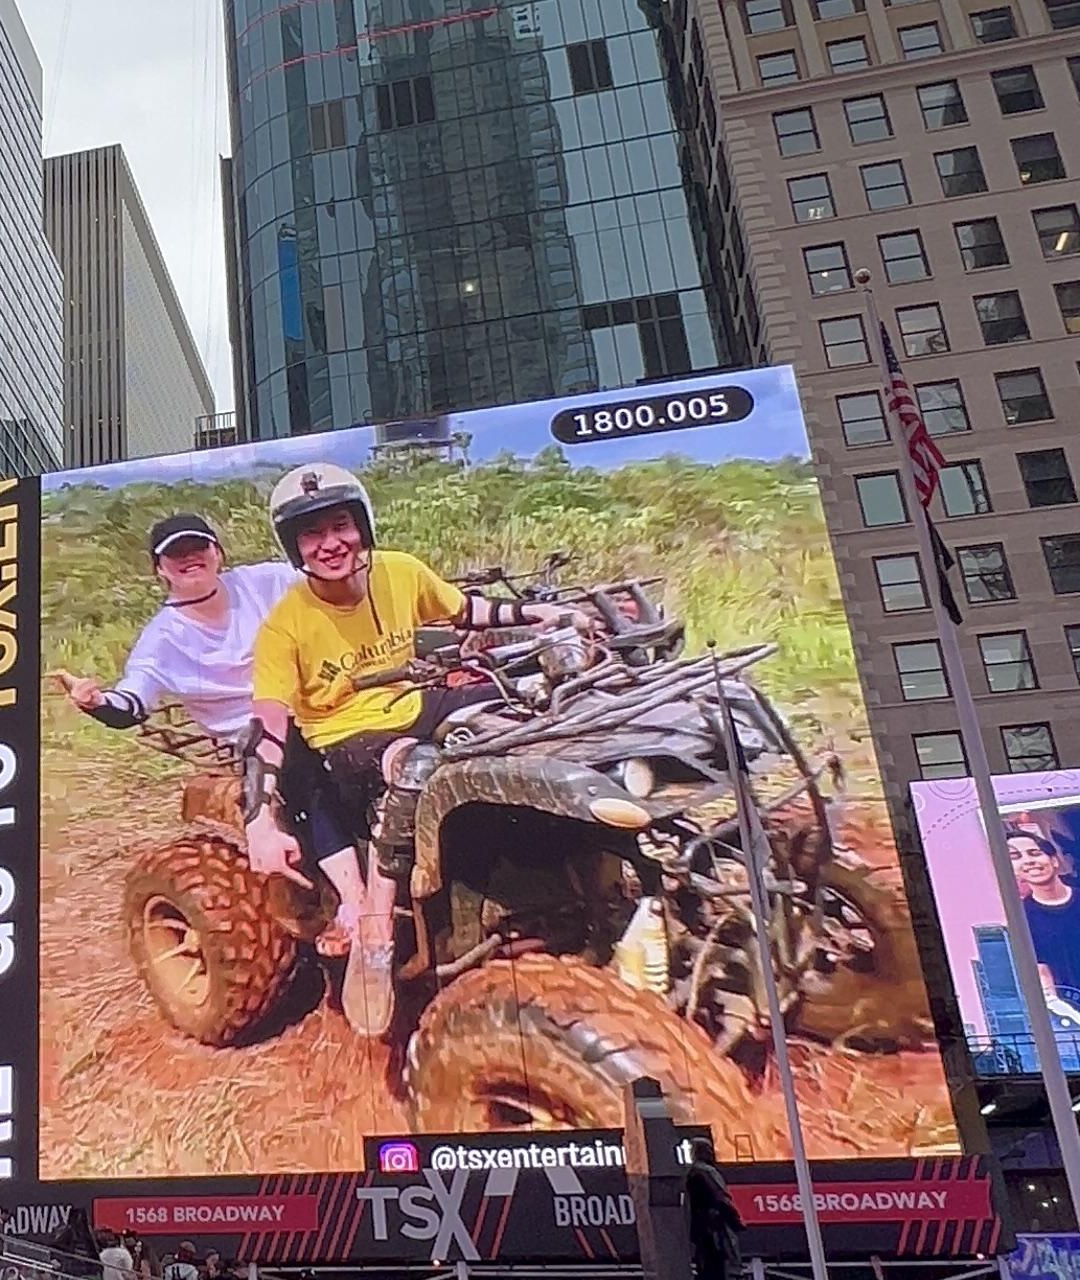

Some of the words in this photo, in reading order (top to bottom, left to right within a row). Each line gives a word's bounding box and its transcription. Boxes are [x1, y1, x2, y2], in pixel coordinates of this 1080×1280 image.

[573, 394, 729, 436] 1800.005
[126, 1207, 168, 1224] 1568
[173, 1204, 285, 1222] BROADWAY
[356, 1169, 481, 1261] TSX
[554, 1193, 636, 1226] BROAD
[753, 1194, 804, 1212] 1568
[813, 1191, 947, 1211] BROADWAY
[4, 1205, 72, 1235] ADWAY
